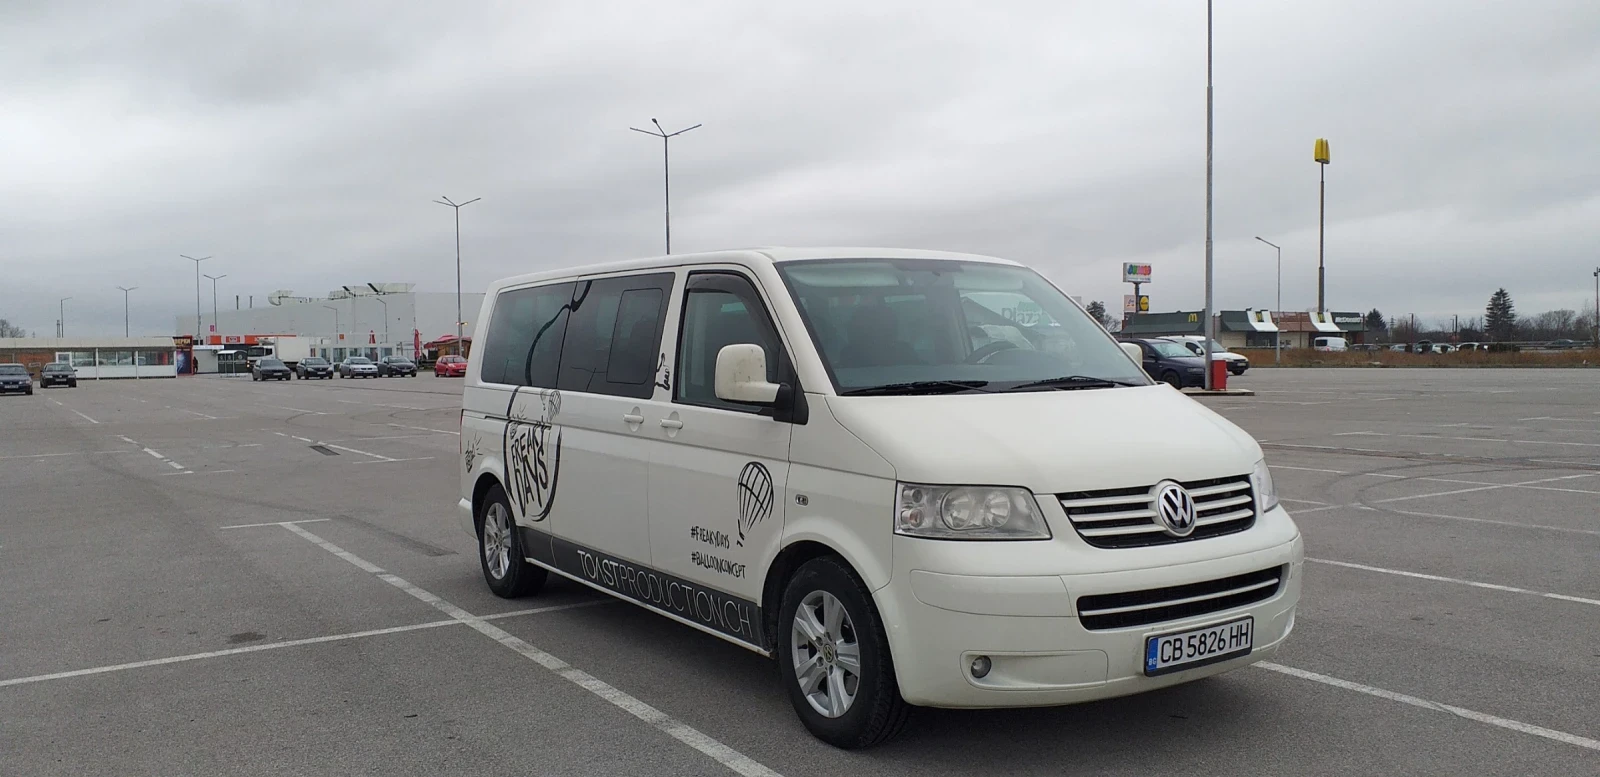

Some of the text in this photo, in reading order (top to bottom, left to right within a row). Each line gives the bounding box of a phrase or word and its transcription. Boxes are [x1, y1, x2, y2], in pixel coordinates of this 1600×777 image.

[514, 447, 548, 518] DAYS
[691, 551, 747, 579] #BALLOONCONCEPT
[1161, 623, 1249, 663] CB 5826 HH
